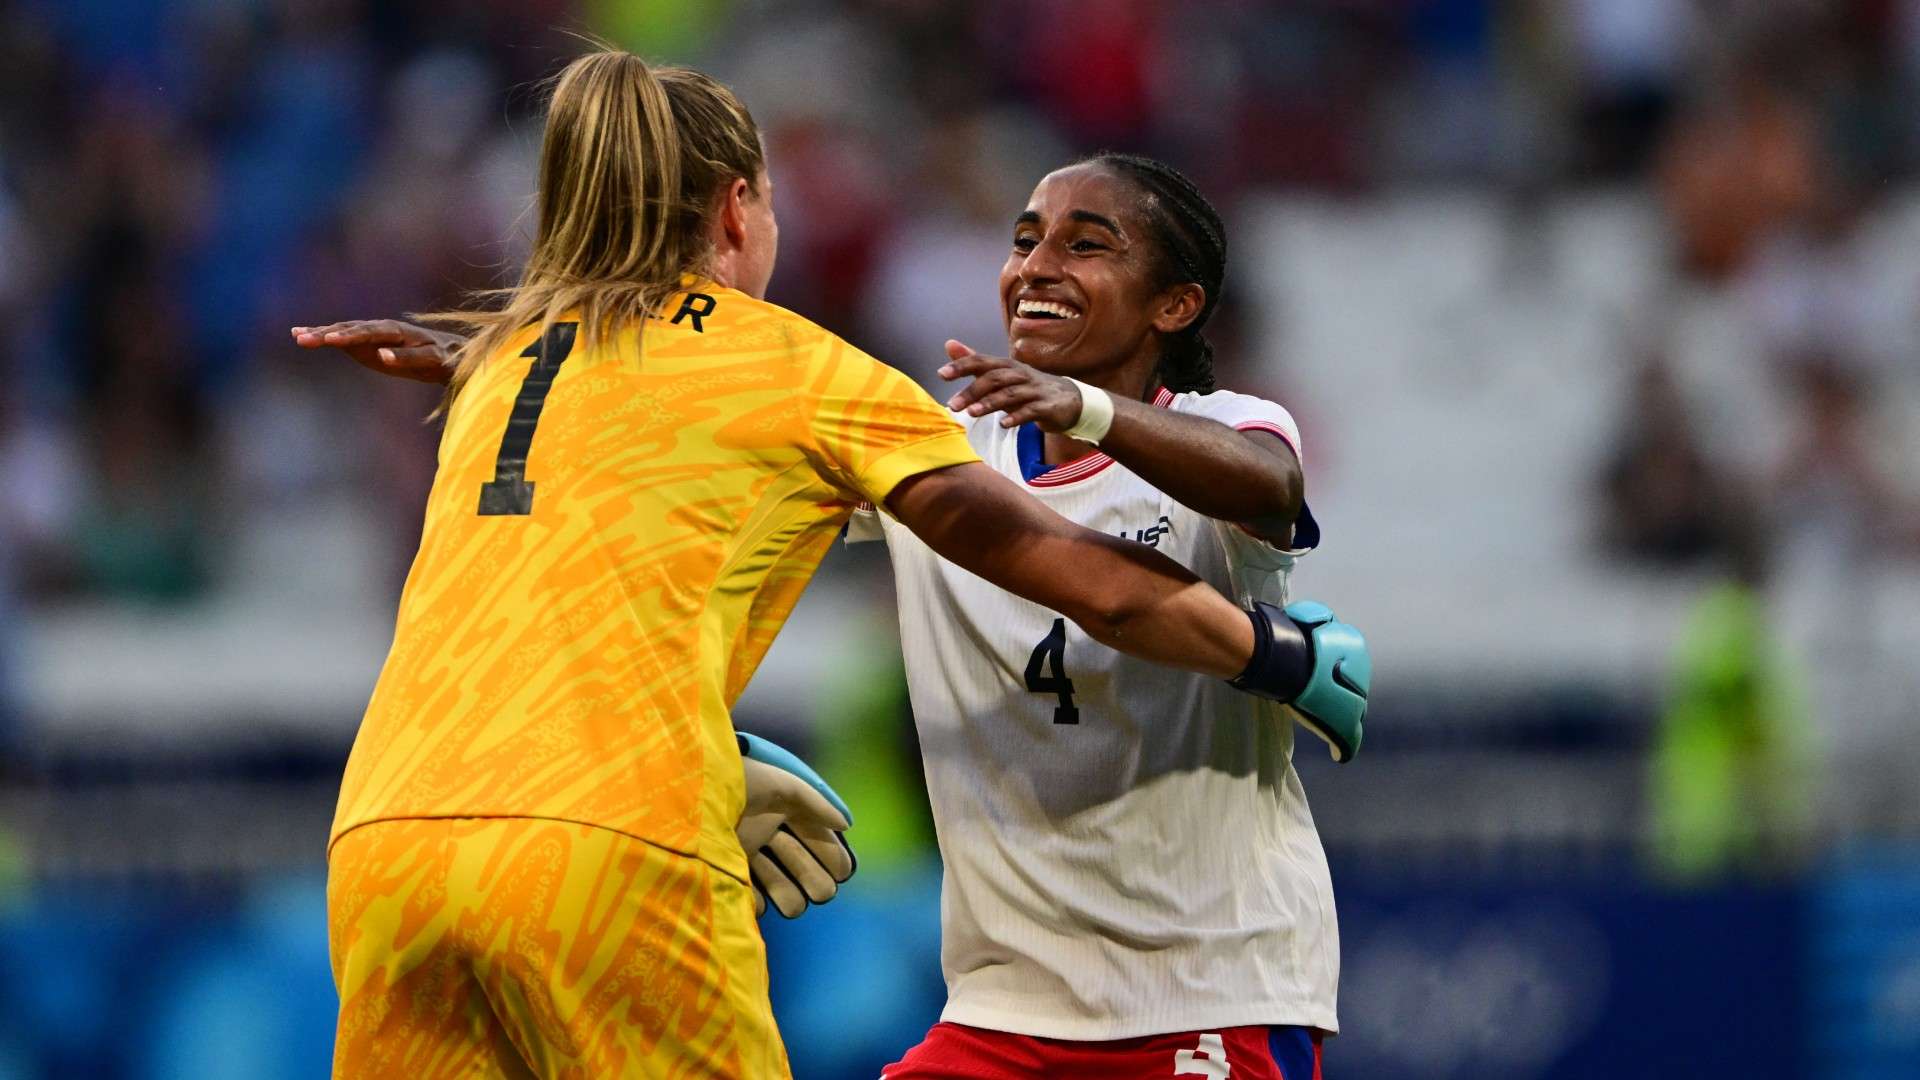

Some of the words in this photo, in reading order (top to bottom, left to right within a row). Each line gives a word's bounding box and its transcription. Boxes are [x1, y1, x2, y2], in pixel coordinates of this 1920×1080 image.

[648, 293, 717, 333] R
[477, 322, 579, 516] 1
[1024, 618, 1080, 724] 4
[1174, 1033, 1231, 1080] 4
